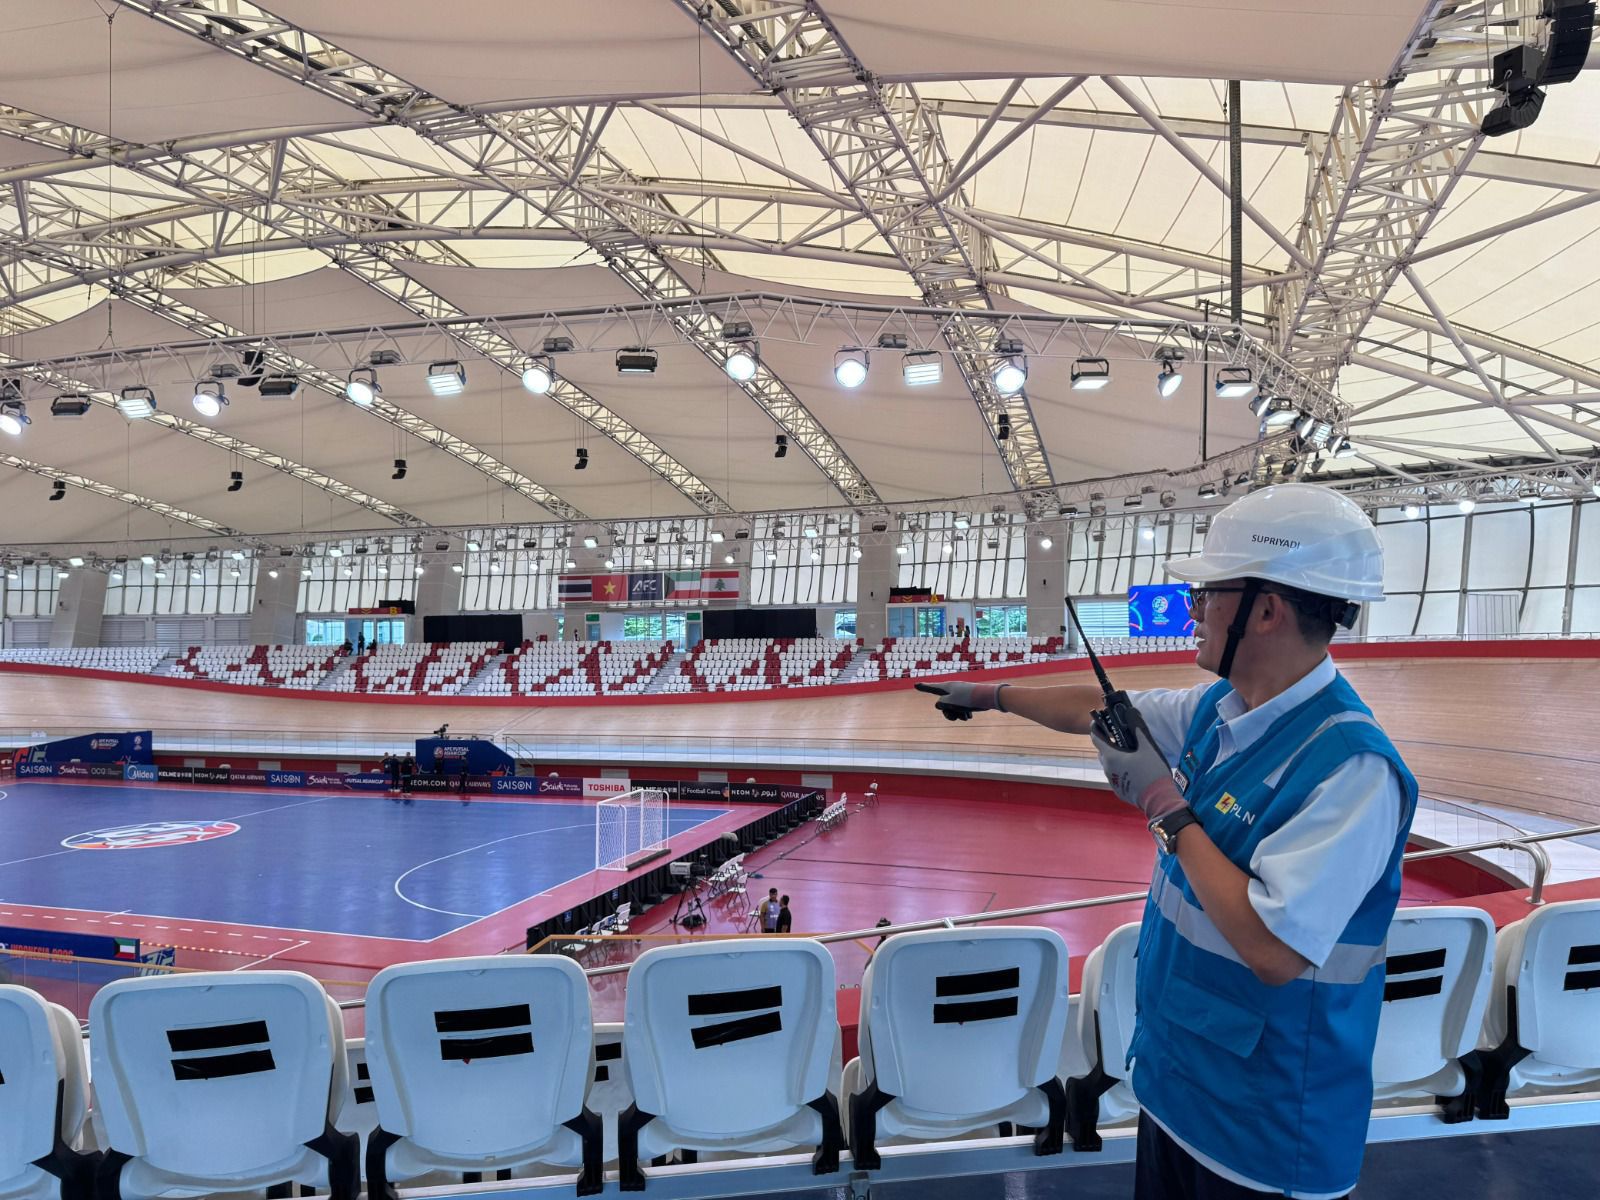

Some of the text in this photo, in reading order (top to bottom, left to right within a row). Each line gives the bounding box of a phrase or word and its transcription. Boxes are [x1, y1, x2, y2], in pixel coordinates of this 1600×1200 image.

[1251, 534, 1301, 550] SUPRIYADI
[632, 579, 657, 593] AFC
[20, 765, 52, 774] SAISON
[132, 769, 154, 780] Midea
[271, 774, 301, 784] SAISON
[497, 780, 532, 791] SAISON
[588, 783, 625, 794] TOSHIBA
[780, 791, 800, 800] QATAR
[1229, 803, 1256, 826] PLN
